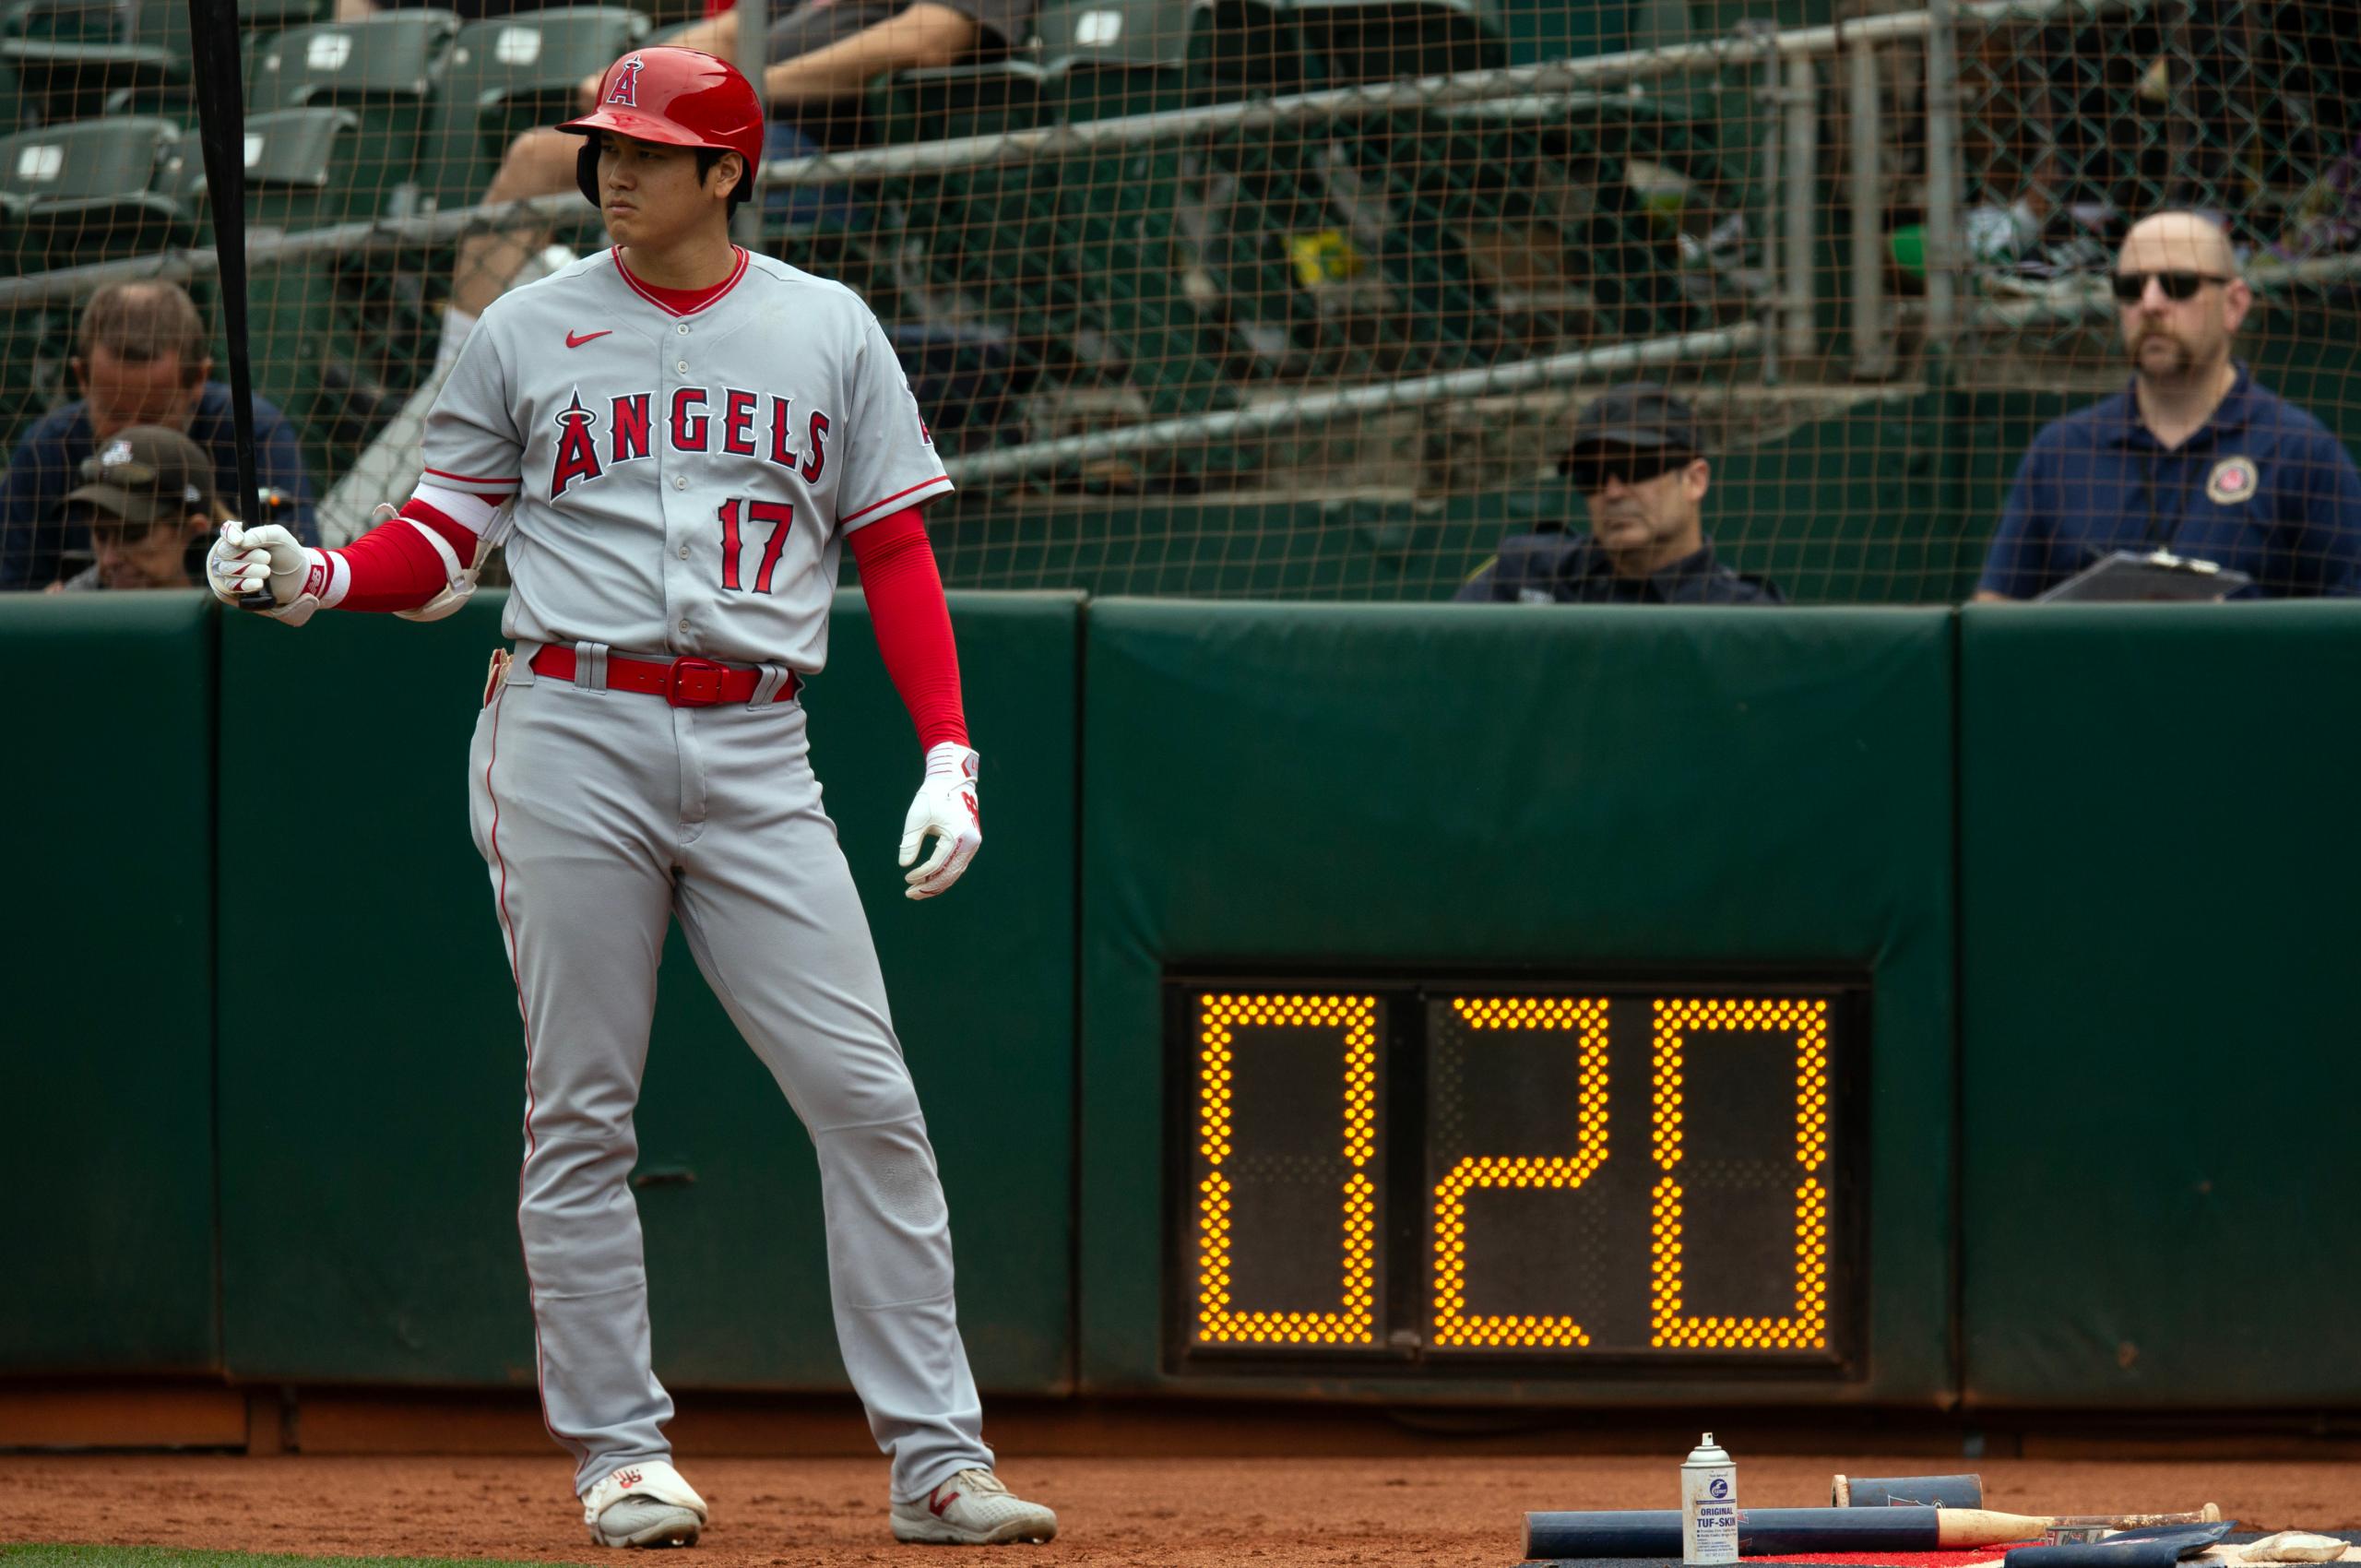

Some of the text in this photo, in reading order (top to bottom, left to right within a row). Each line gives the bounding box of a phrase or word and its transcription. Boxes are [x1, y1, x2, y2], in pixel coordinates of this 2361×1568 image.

[606, 54, 644, 107] A
[550, 383, 831, 505] ANGELS
[717, 497, 794, 596] 17
[1697, 1517, 1736, 1527] TUF-SKIN
[1701, 1507, 1733, 1516] ORIGINAL
